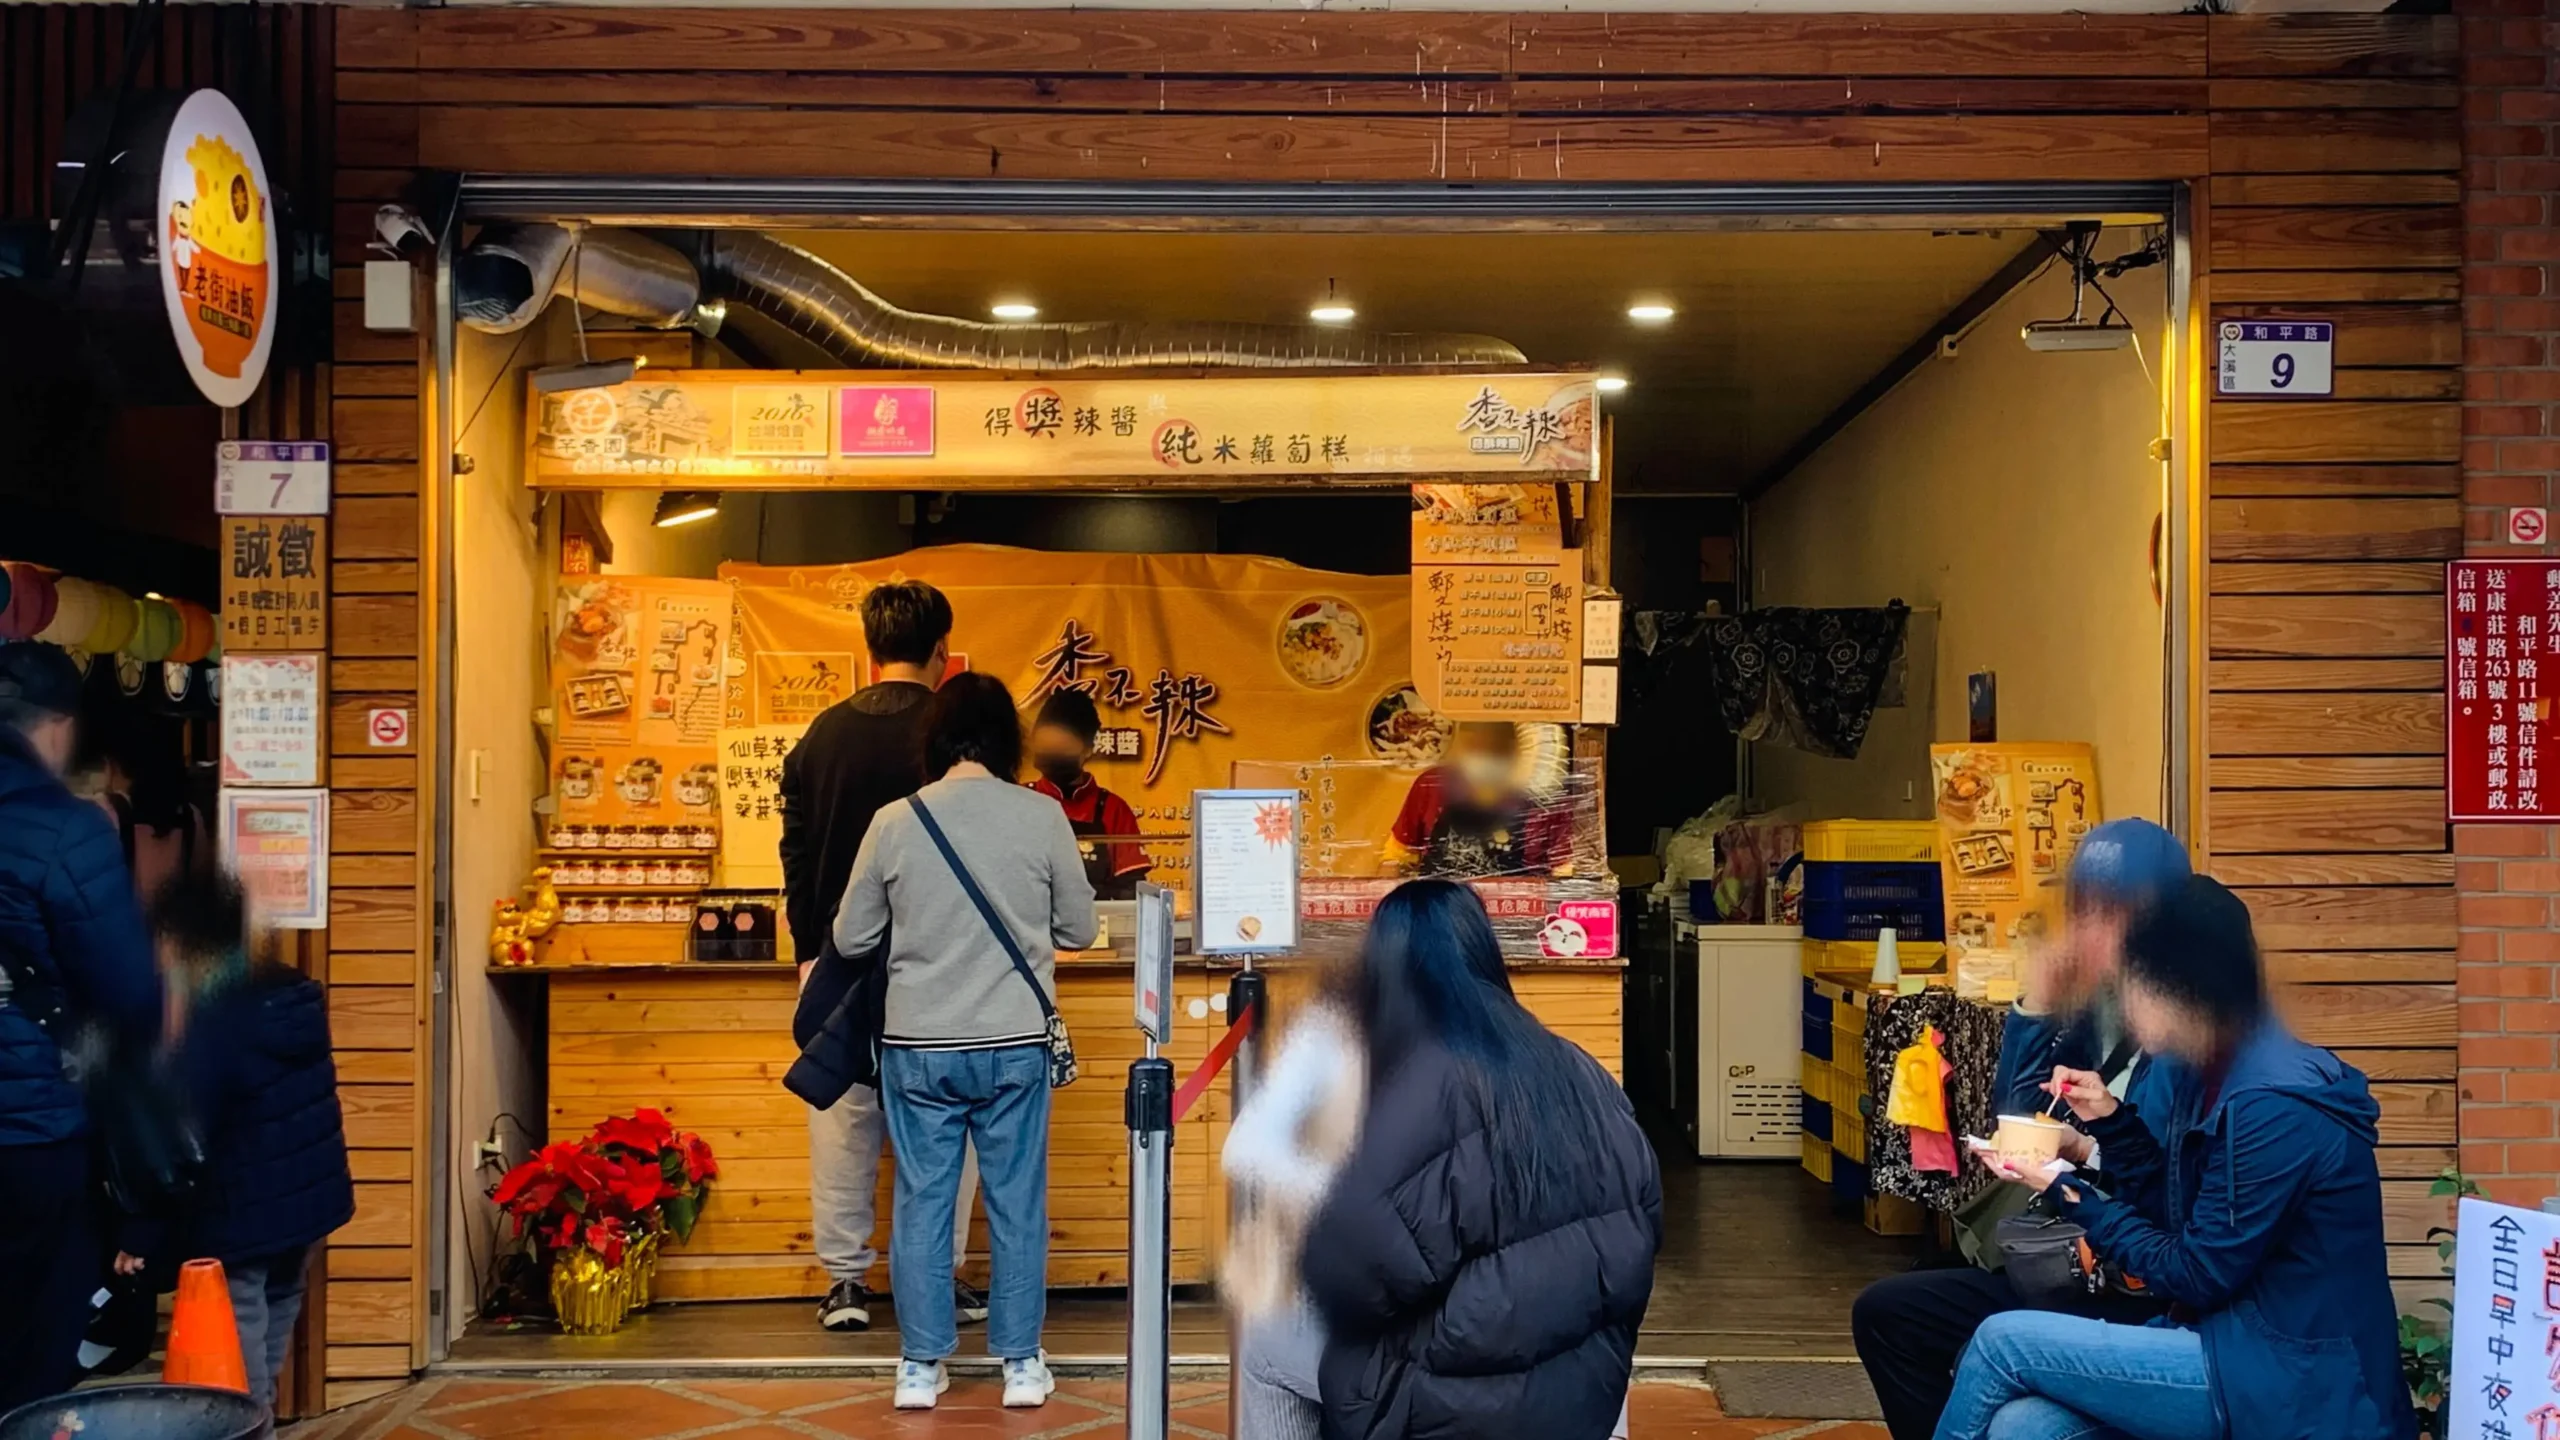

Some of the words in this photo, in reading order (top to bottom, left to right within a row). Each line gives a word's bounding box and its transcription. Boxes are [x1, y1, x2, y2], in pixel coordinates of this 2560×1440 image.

[194, 261, 255, 321] 老街油飯
[2254, 326, 2318, 340] 和平路
[2223, 344, 2236, 390] 大溪區
[2270, 353, 2295, 388] 9
[751, 404, 814, 421] 2016
[984, 397, 1137, 438] 得獎辣醬
[252, 446, 315, 459] 和平路
[1161, 425, 1349, 465] 純米蘿蔔糕
[269, 473, 292, 508] 7
[234, 525, 316, 579] 誠徵
[2457, 569, 2477, 716] 信箱號信箱。
[771, 672, 839, 691] 2016
[2485, 569, 2510, 810] 送康莊路263號3樓或郵政
[2517, 615, 2538, 810] 和平路11號信件請改
[729, 736, 787, 760] 仙草茶
